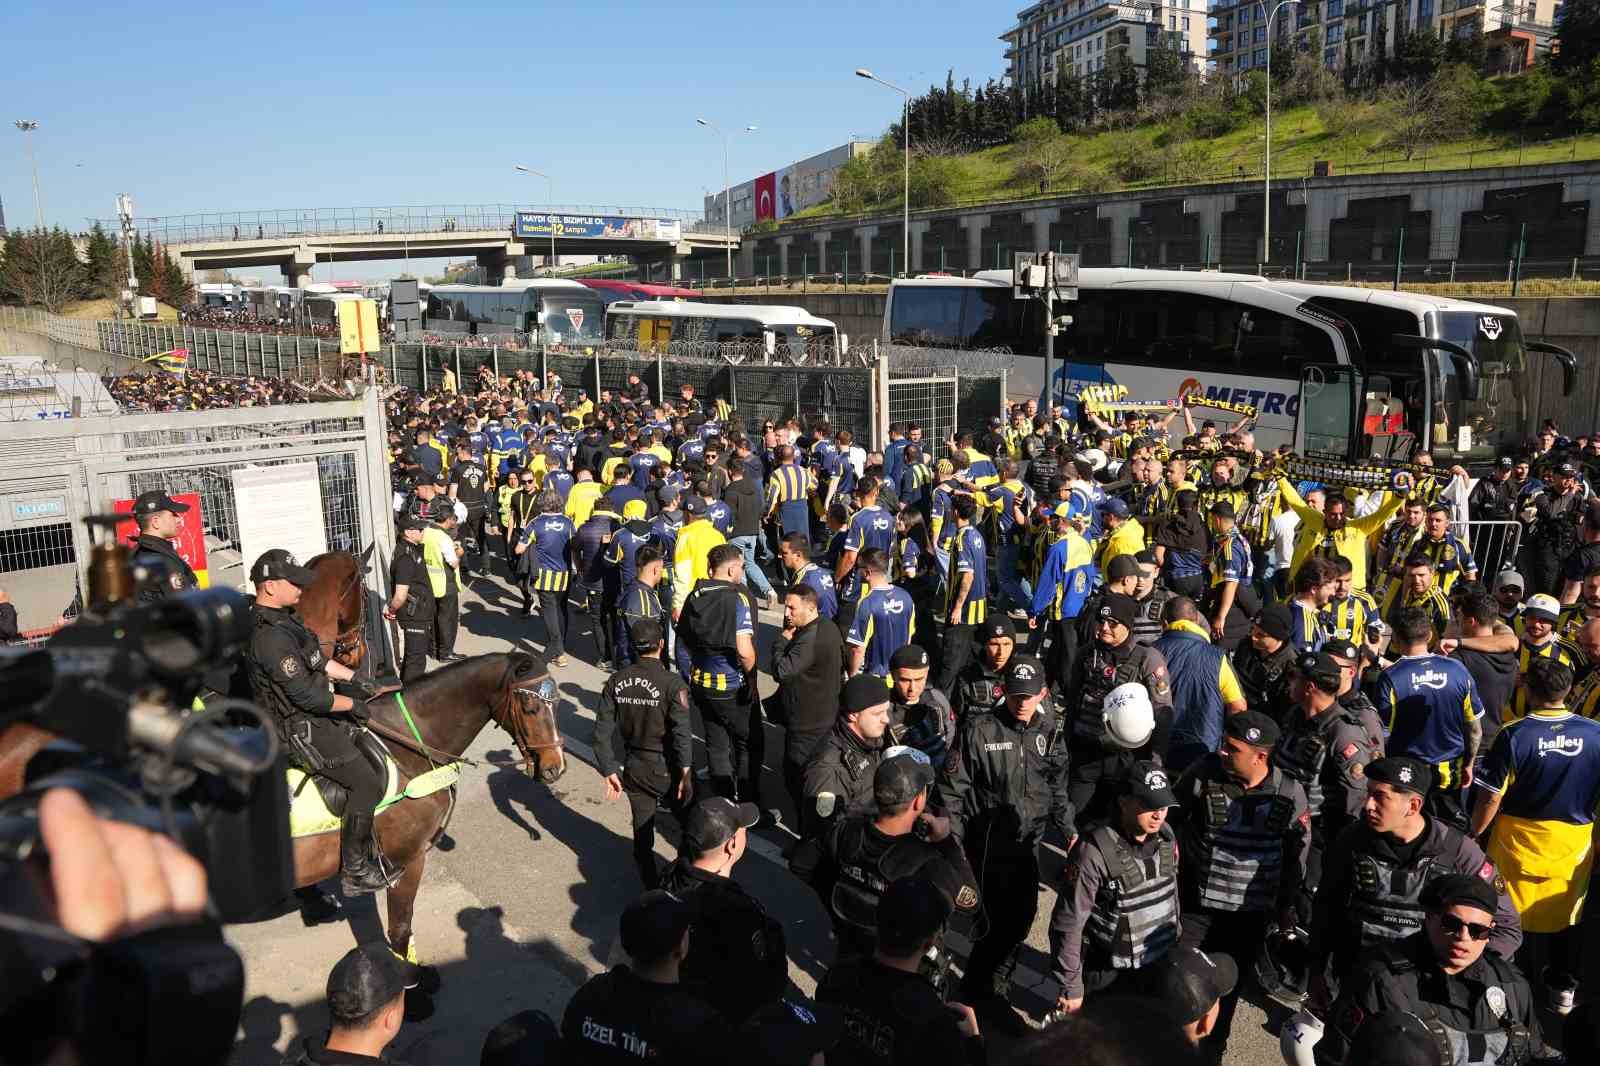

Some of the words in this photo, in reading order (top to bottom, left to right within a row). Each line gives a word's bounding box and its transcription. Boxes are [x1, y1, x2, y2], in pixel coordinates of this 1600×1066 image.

[1187, 394, 1257, 416] ESENLER
[614, 678, 632, 695] ATLI
[1411, 669, 1448, 690] halley
[1538, 735, 1584, 757] halley
[582, 1015, 617, 1048] ÖZEL
[621, 1031, 647, 1058] TİM
